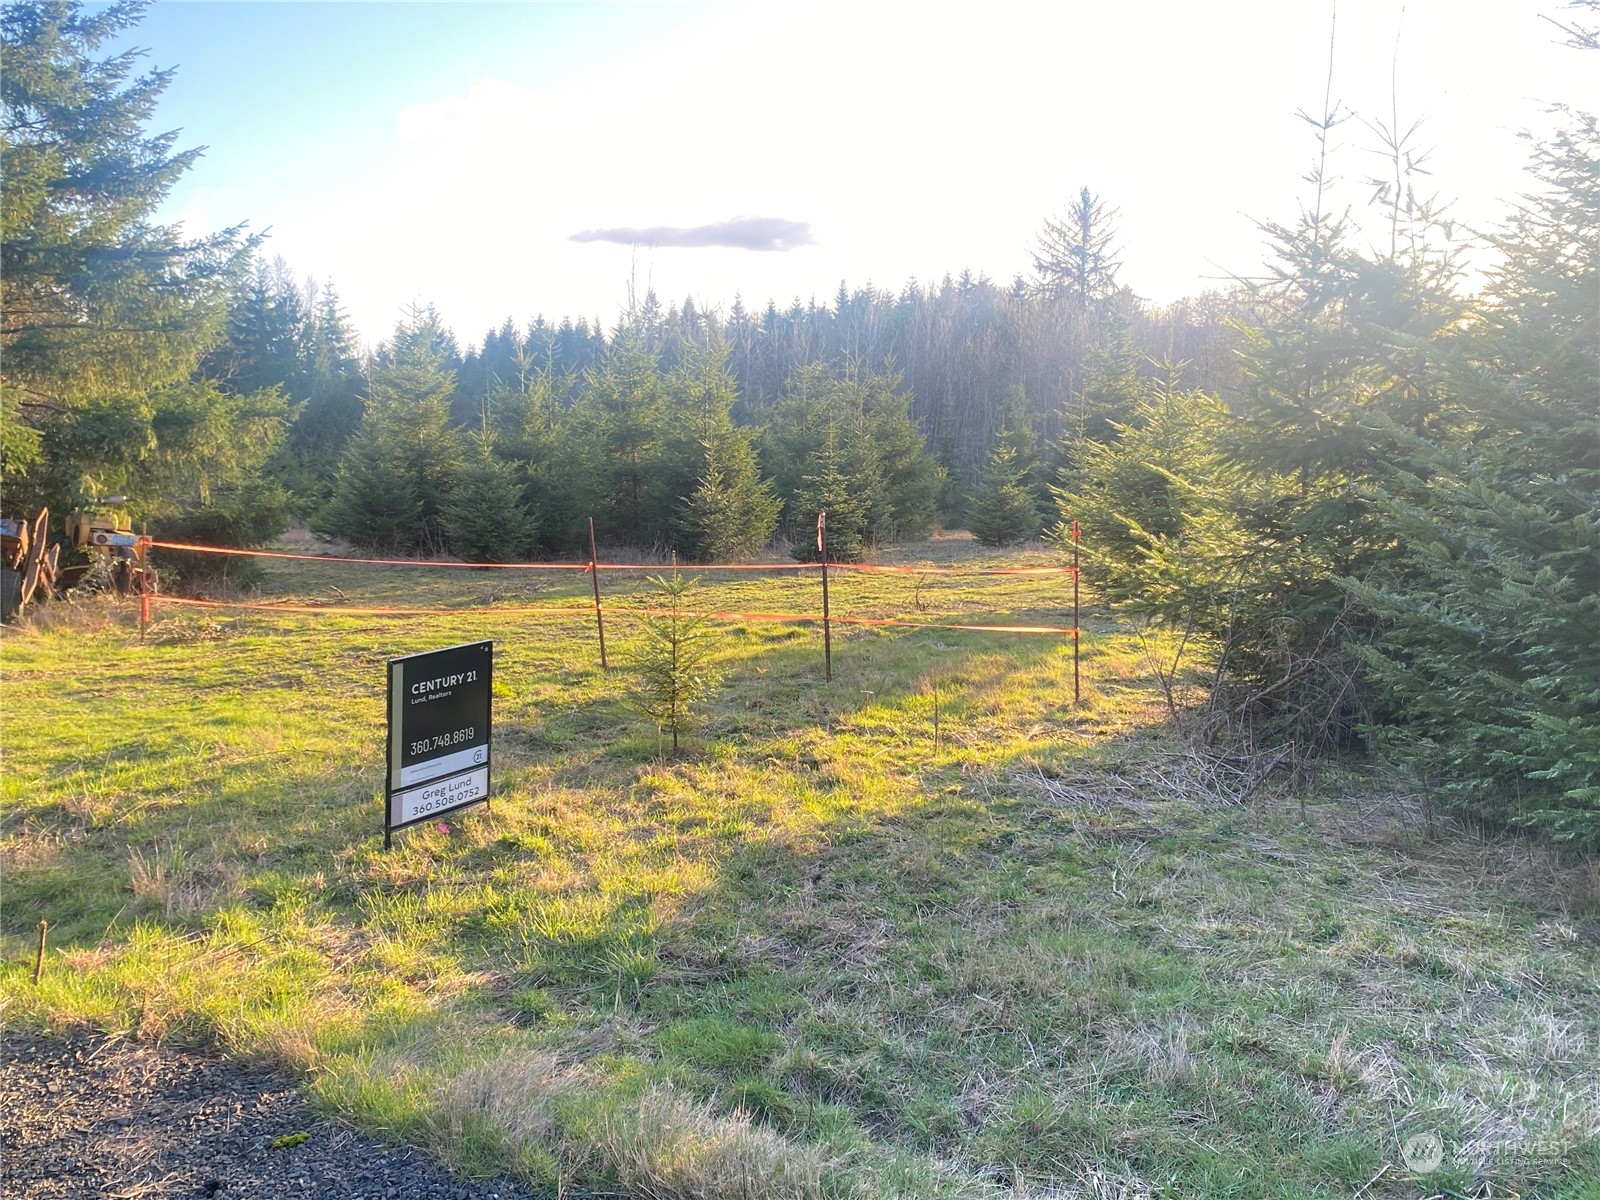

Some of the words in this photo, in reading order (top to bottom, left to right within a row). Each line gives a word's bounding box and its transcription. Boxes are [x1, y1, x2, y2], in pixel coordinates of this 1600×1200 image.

[411, 673, 465, 694] CENTURY
[411, 696, 428, 705] Lund,
[428, 690, 452, 701] Realtors
[410, 727, 474, 756] 360.748.8619
[422, 786, 446, 800] Greg
[449, 777, 472, 792] Lund
[412, 786, 480, 816] 360.508.0752
